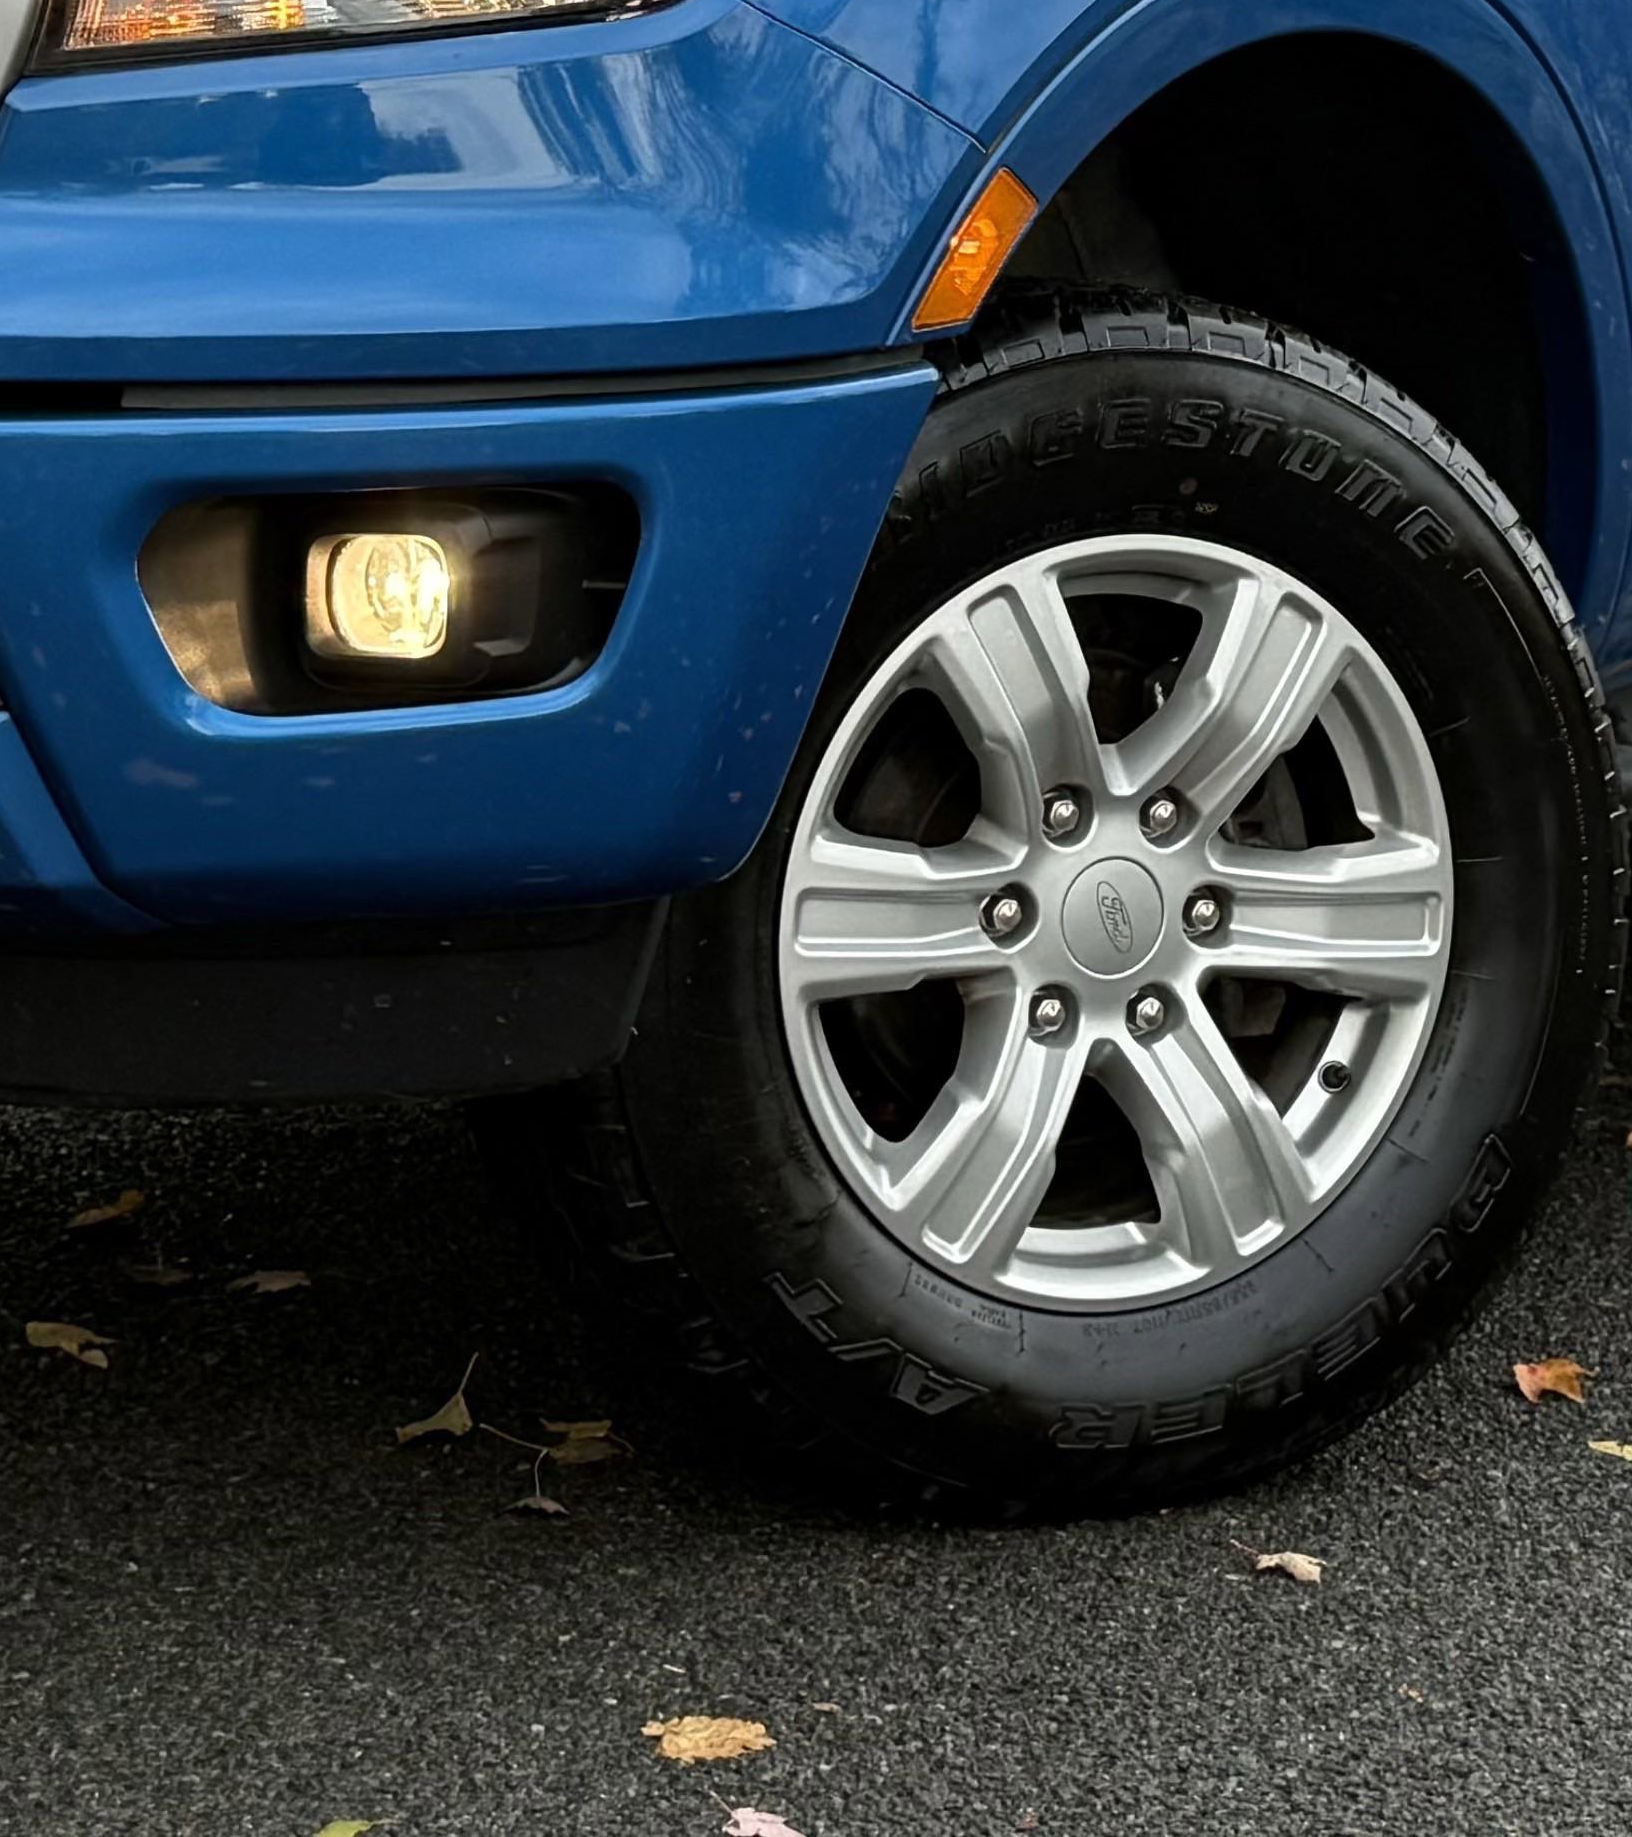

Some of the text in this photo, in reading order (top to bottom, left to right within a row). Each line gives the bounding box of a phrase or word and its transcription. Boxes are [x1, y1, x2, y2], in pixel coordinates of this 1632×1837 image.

[885, 397, 1455, 561] IDGESTONE
[1101, 895, 1130, 944] Ford
[1049, 1133, 1512, 1449] DUELER
